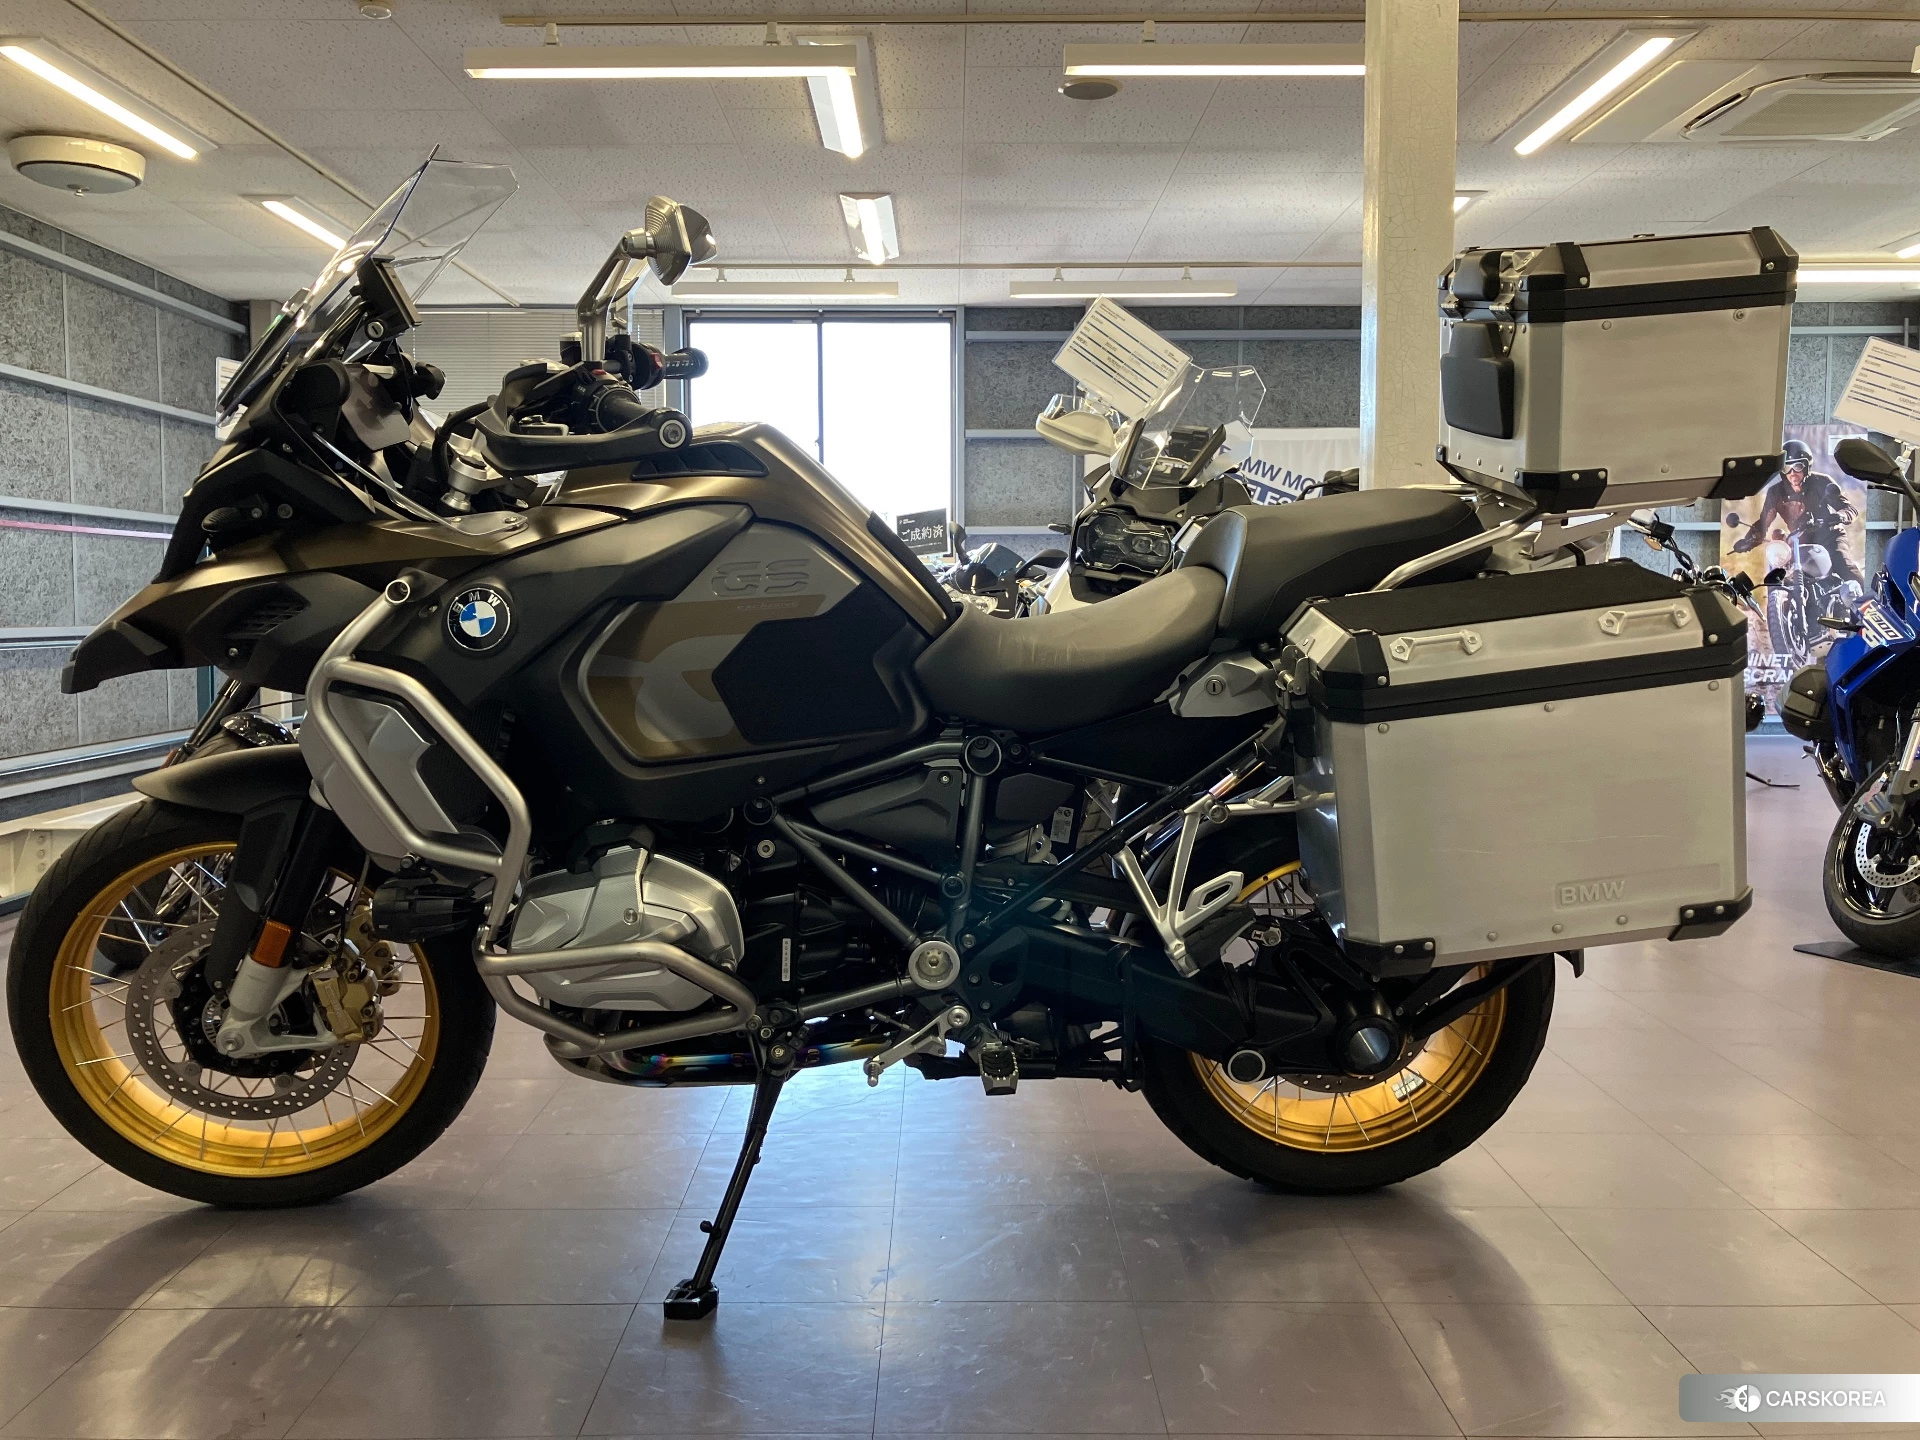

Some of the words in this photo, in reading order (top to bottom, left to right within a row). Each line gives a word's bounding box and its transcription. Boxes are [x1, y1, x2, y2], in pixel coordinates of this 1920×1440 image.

[1239, 456, 1282, 482] MW
[1282, 471, 1322, 498] MO
[901, 524, 944, 542] ご成約済
[711, 559, 809, 597] GS
[452, 591, 501, 614] BMW
[1561, 880, 1626, 905] BMW
